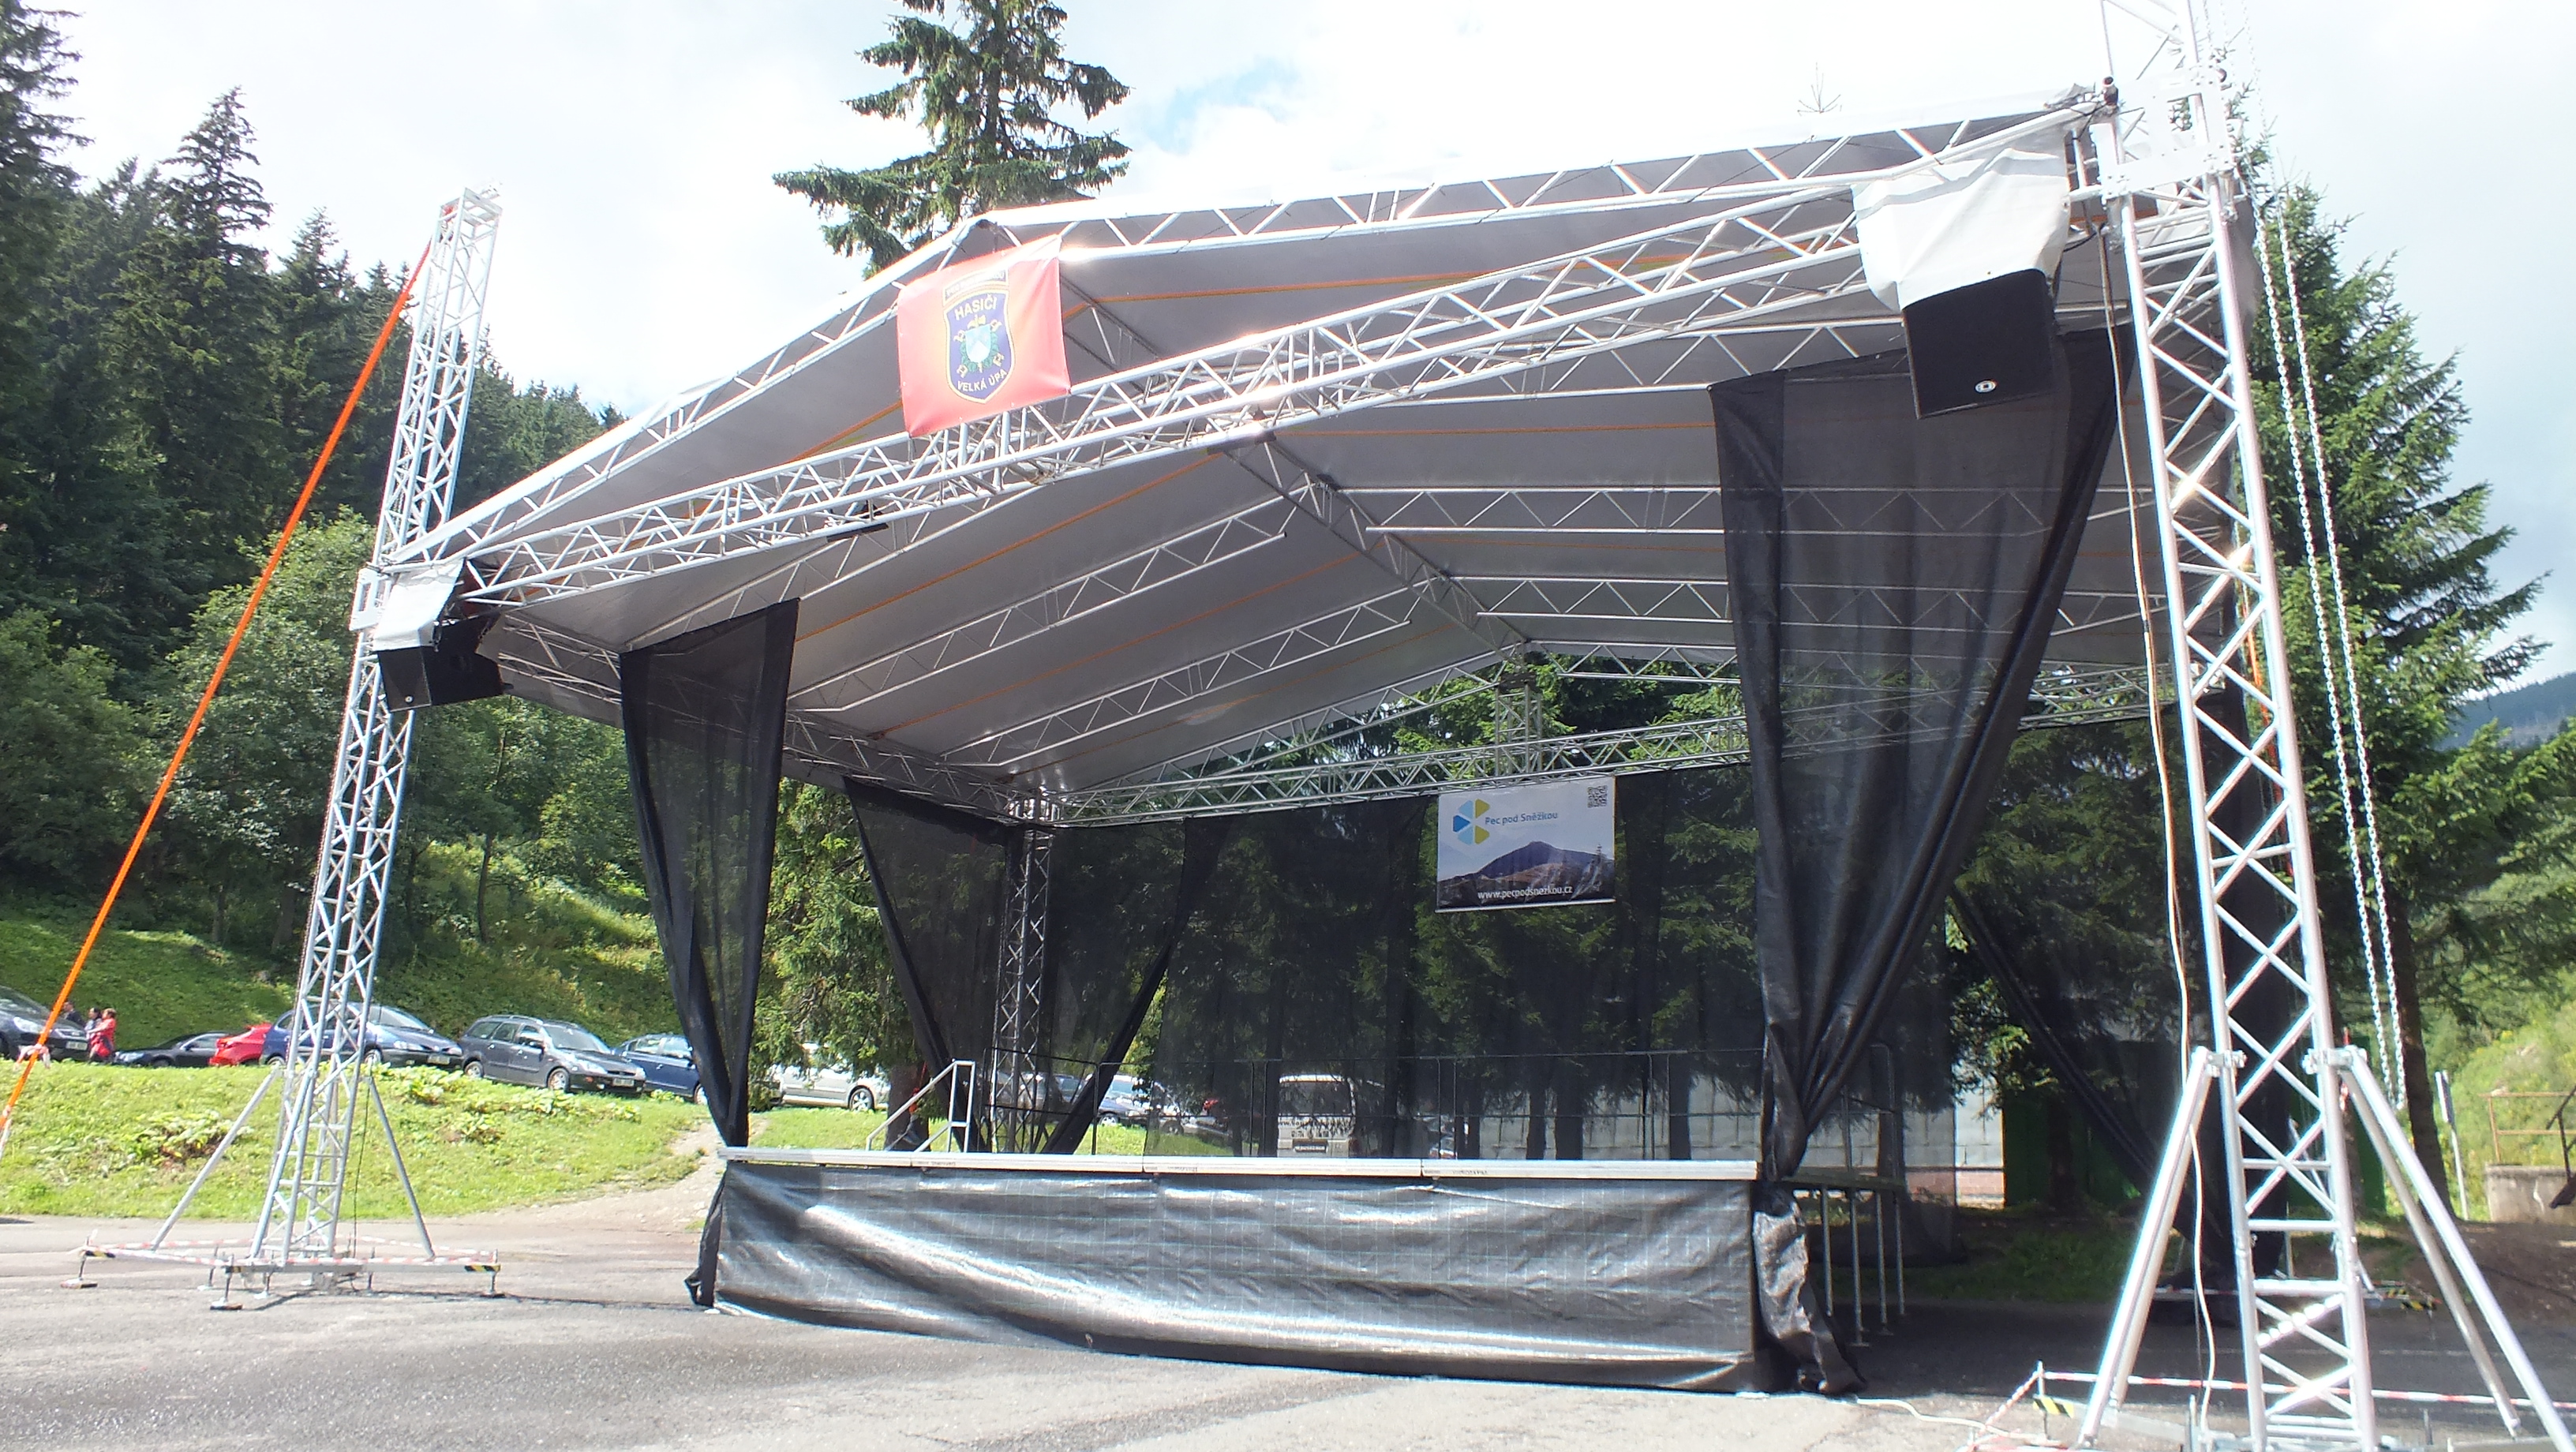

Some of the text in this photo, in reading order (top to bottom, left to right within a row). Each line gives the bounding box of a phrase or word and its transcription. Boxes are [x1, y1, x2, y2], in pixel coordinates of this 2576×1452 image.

[954, 294, 998, 320] HASIČI
[957, 377, 987, 392] VELKÁ
[1502, 814, 1518, 825] pod
[1521, 812, 1558, 821] Sněžkou
[1477, 886, 1572, 900] www.pecpodsnezkou.cz
